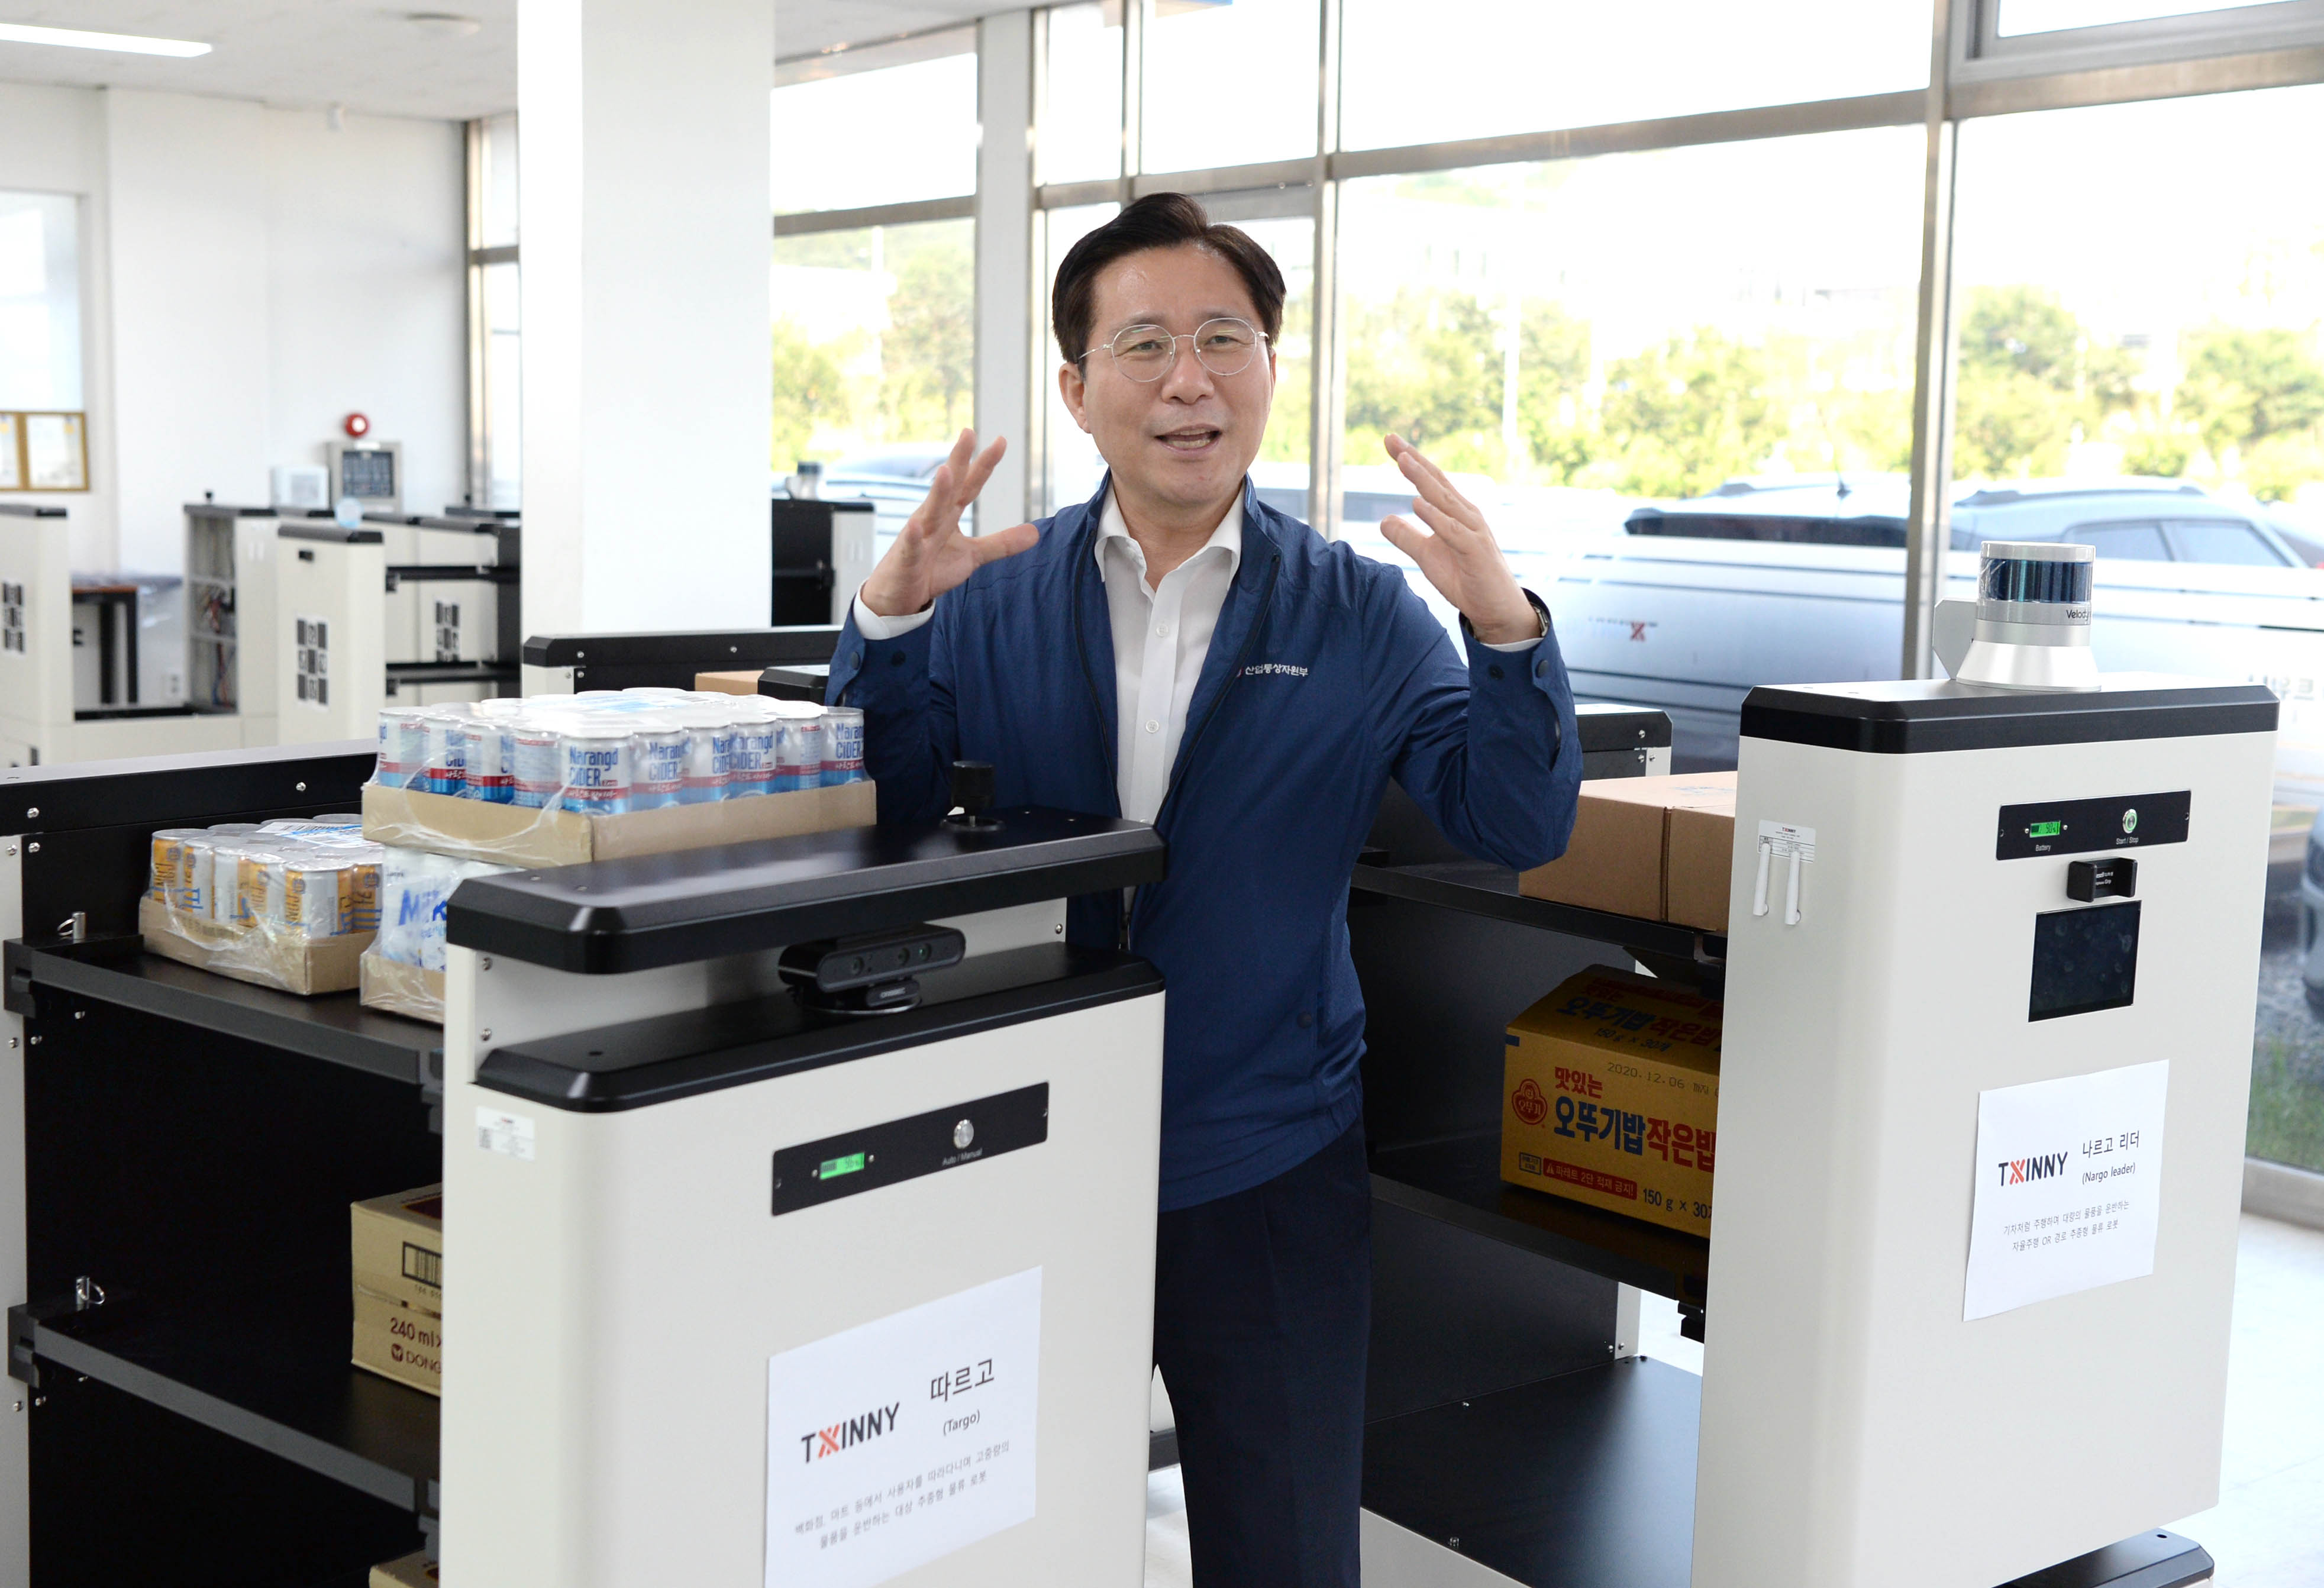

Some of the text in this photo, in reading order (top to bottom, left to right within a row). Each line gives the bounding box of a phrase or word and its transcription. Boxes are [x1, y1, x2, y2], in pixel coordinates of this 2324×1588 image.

[1245, 663, 1309, 677] 산업통상자원부
[570, 745, 618, 772] Narangd
[2035, 844, 2051, 852] Battery
[2129, 836, 2139, 844] Stop
[1554, 1066, 1603, 1099] 맛있는
[1607, 1063, 1685, 1089] 2020.12.06
[1554, 1095, 1645, 1156] 오뚜기밥
[2082, 1130, 2140, 1158] 나르고 리더
[942, 1156, 956, 1166] Auto
[960, 1148, 983, 1162] Manual
[2081, 1162, 2136, 1185] (Nargo leader)
[1643, 1187, 1662, 1206] 150
[1665, 1197, 1673, 1212] g
[2003, 1221, 2031, 1236] 기차처럼
[2034, 1215, 2060, 1231] 주행하며
[2041, 1235, 2052, 1247] OR
[390, 1316, 415, 1341] 240
[931, 1358, 994, 1402] 따르고
[942, 1409, 980, 1437] (Targo)
